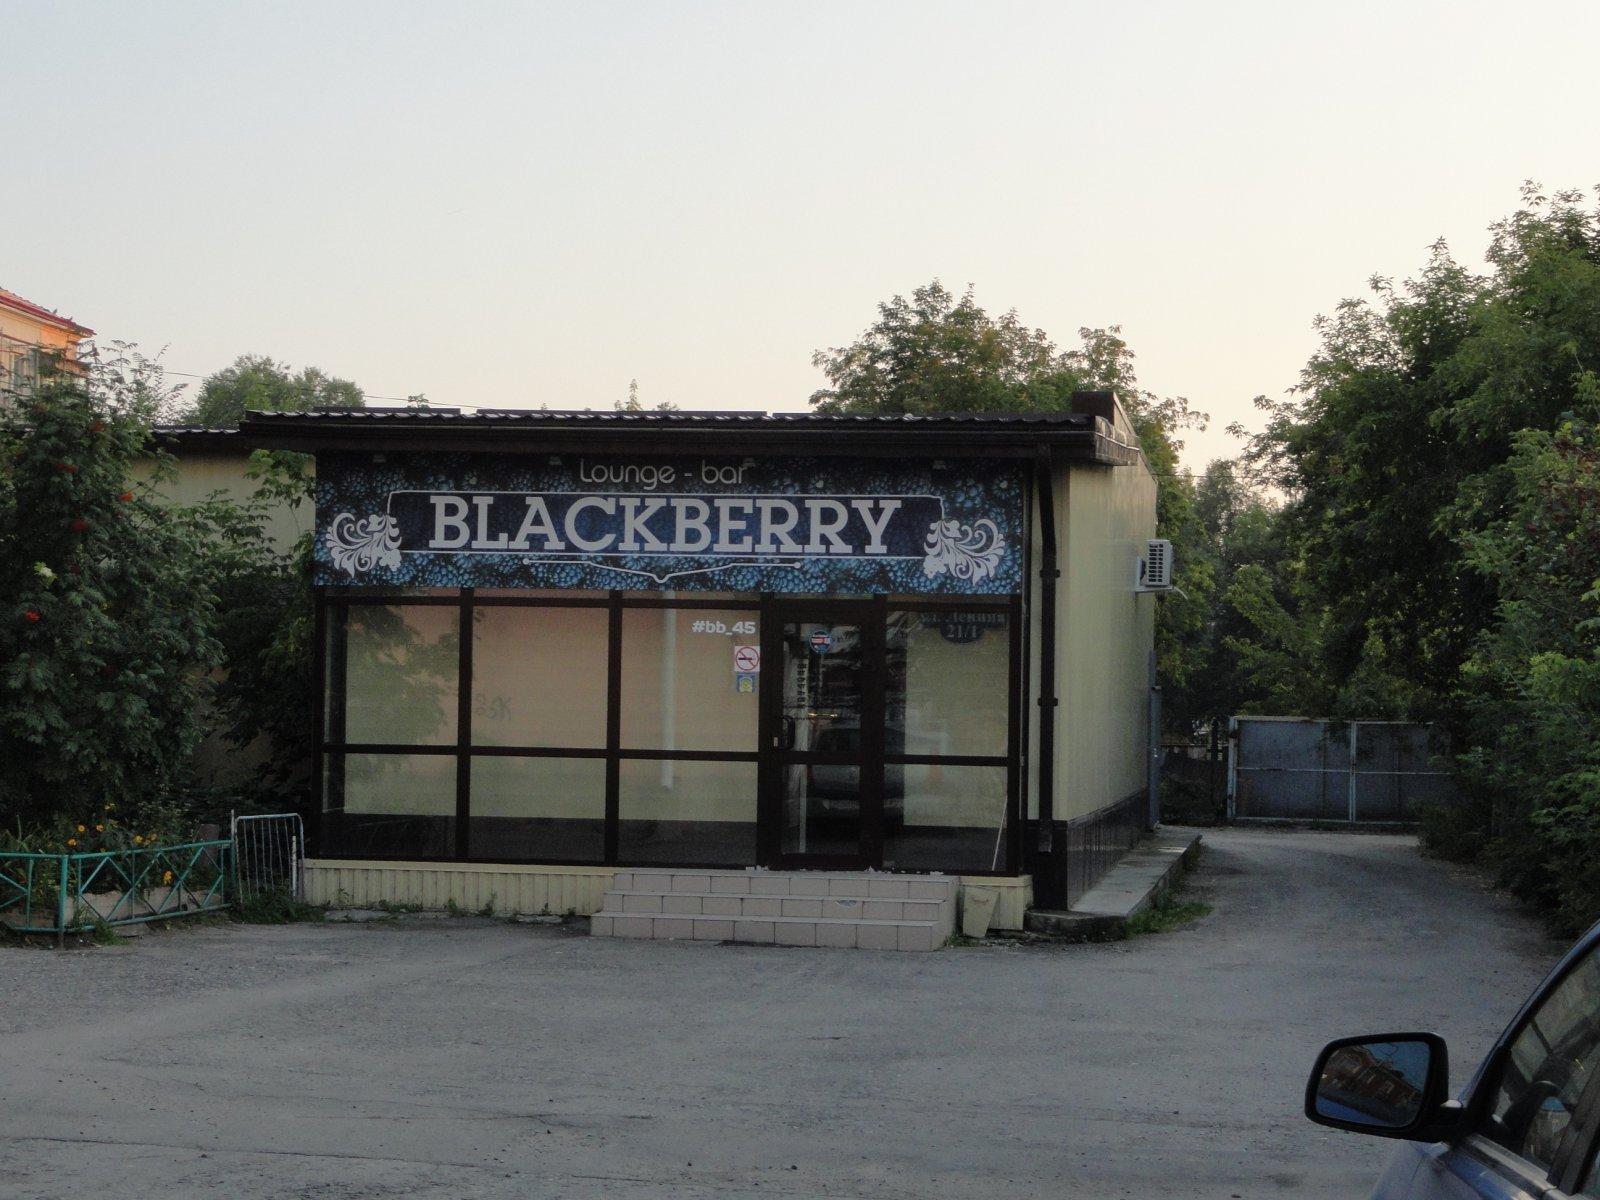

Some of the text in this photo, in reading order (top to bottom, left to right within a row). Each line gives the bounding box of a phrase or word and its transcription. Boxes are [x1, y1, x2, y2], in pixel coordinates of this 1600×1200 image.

[579, 458, 676, 491] Lounge
[701, 459, 748, 484] bar
[428, 495, 902, 556] BLACKBERRY
[691, 620, 756, 636] #bb_45
[947, 624, 977, 639] 21/1
